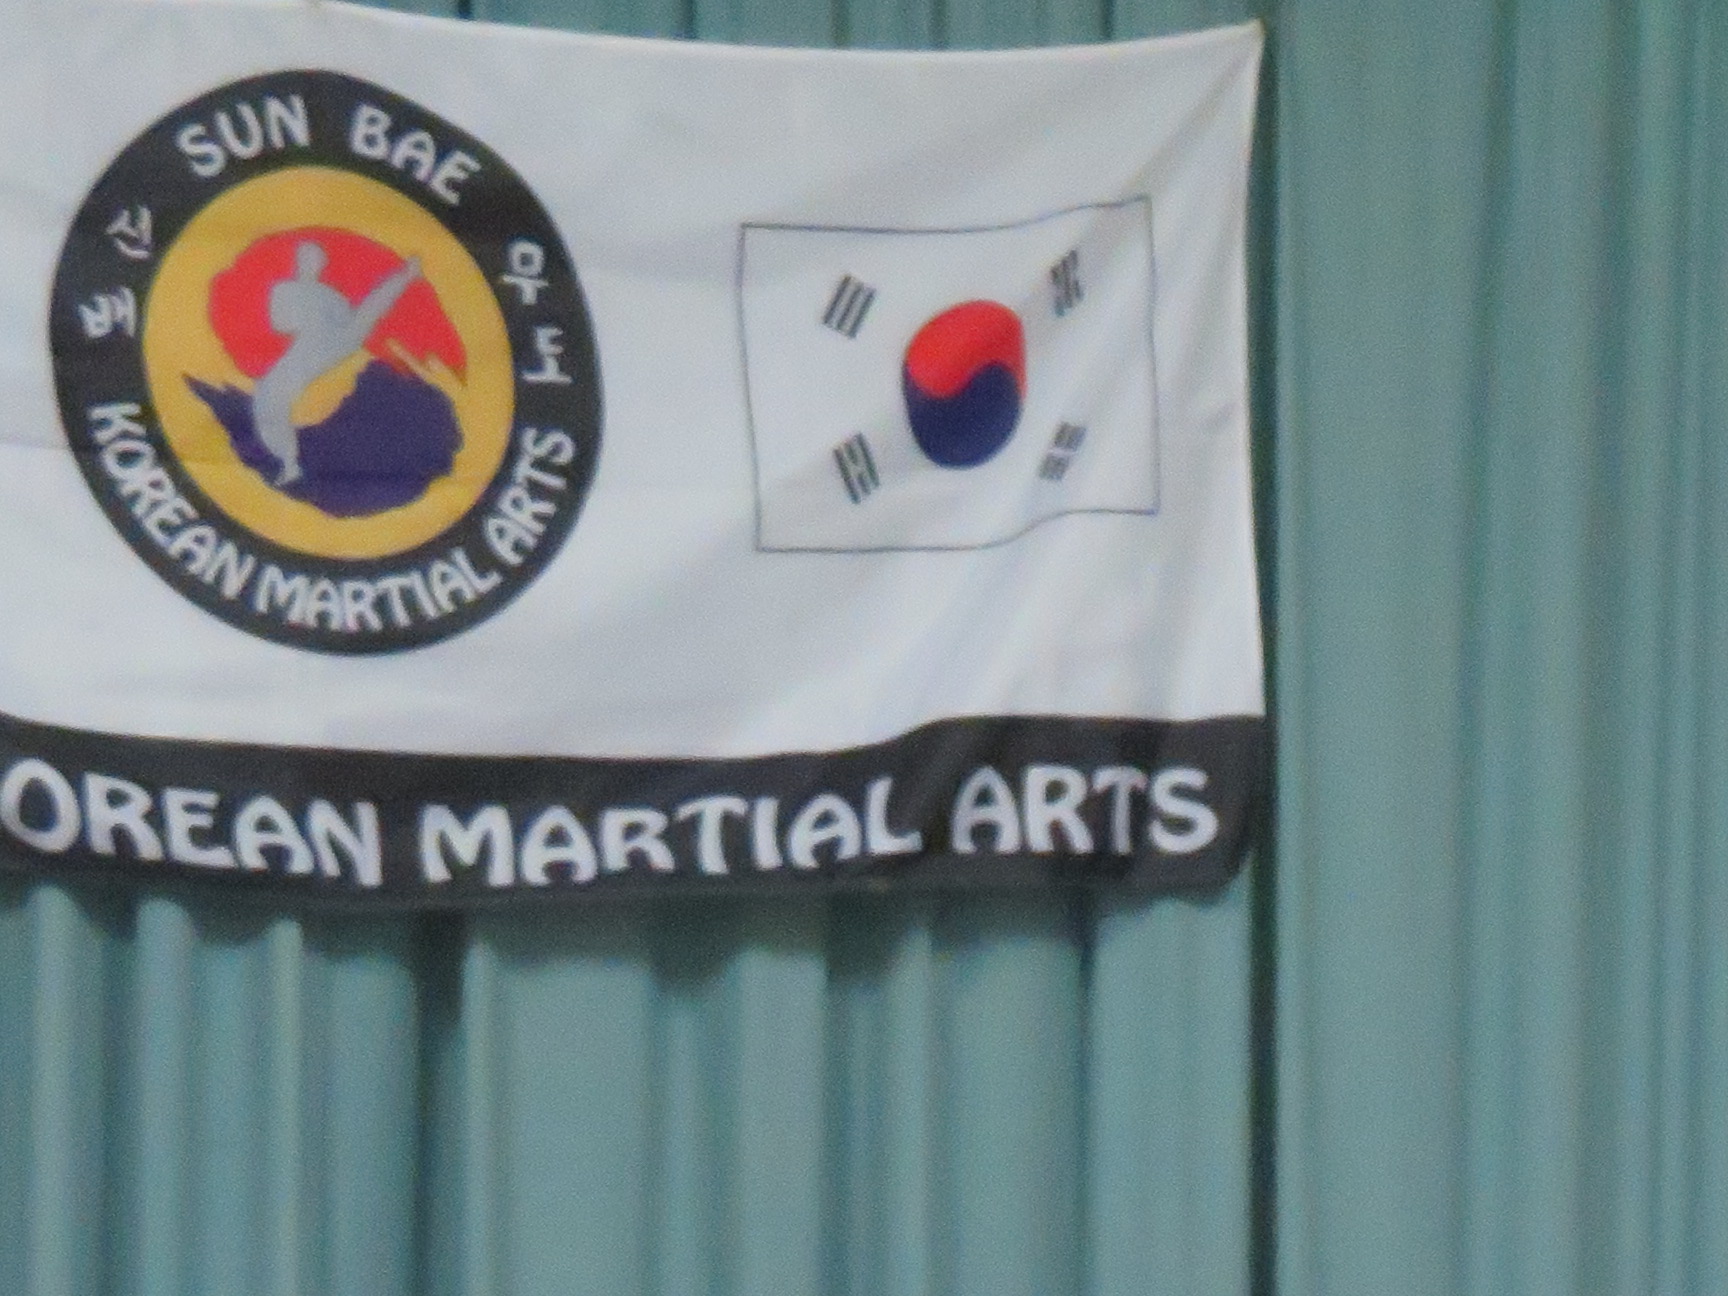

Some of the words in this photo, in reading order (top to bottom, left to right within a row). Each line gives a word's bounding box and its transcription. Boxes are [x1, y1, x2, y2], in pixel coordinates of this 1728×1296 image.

[179, 95, 310, 177] SUN
[350, 104, 480, 205] BAE
[86, 402, 257, 599] KOREAN
[255, 549, 501, 632] MARTIAL
[484, 428, 575, 565] ARTS
[0, 757, 384, 887] OREAN
[417, 775, 925, 887] MARTIAL
[950, 764, 1219, 855] ARTS
